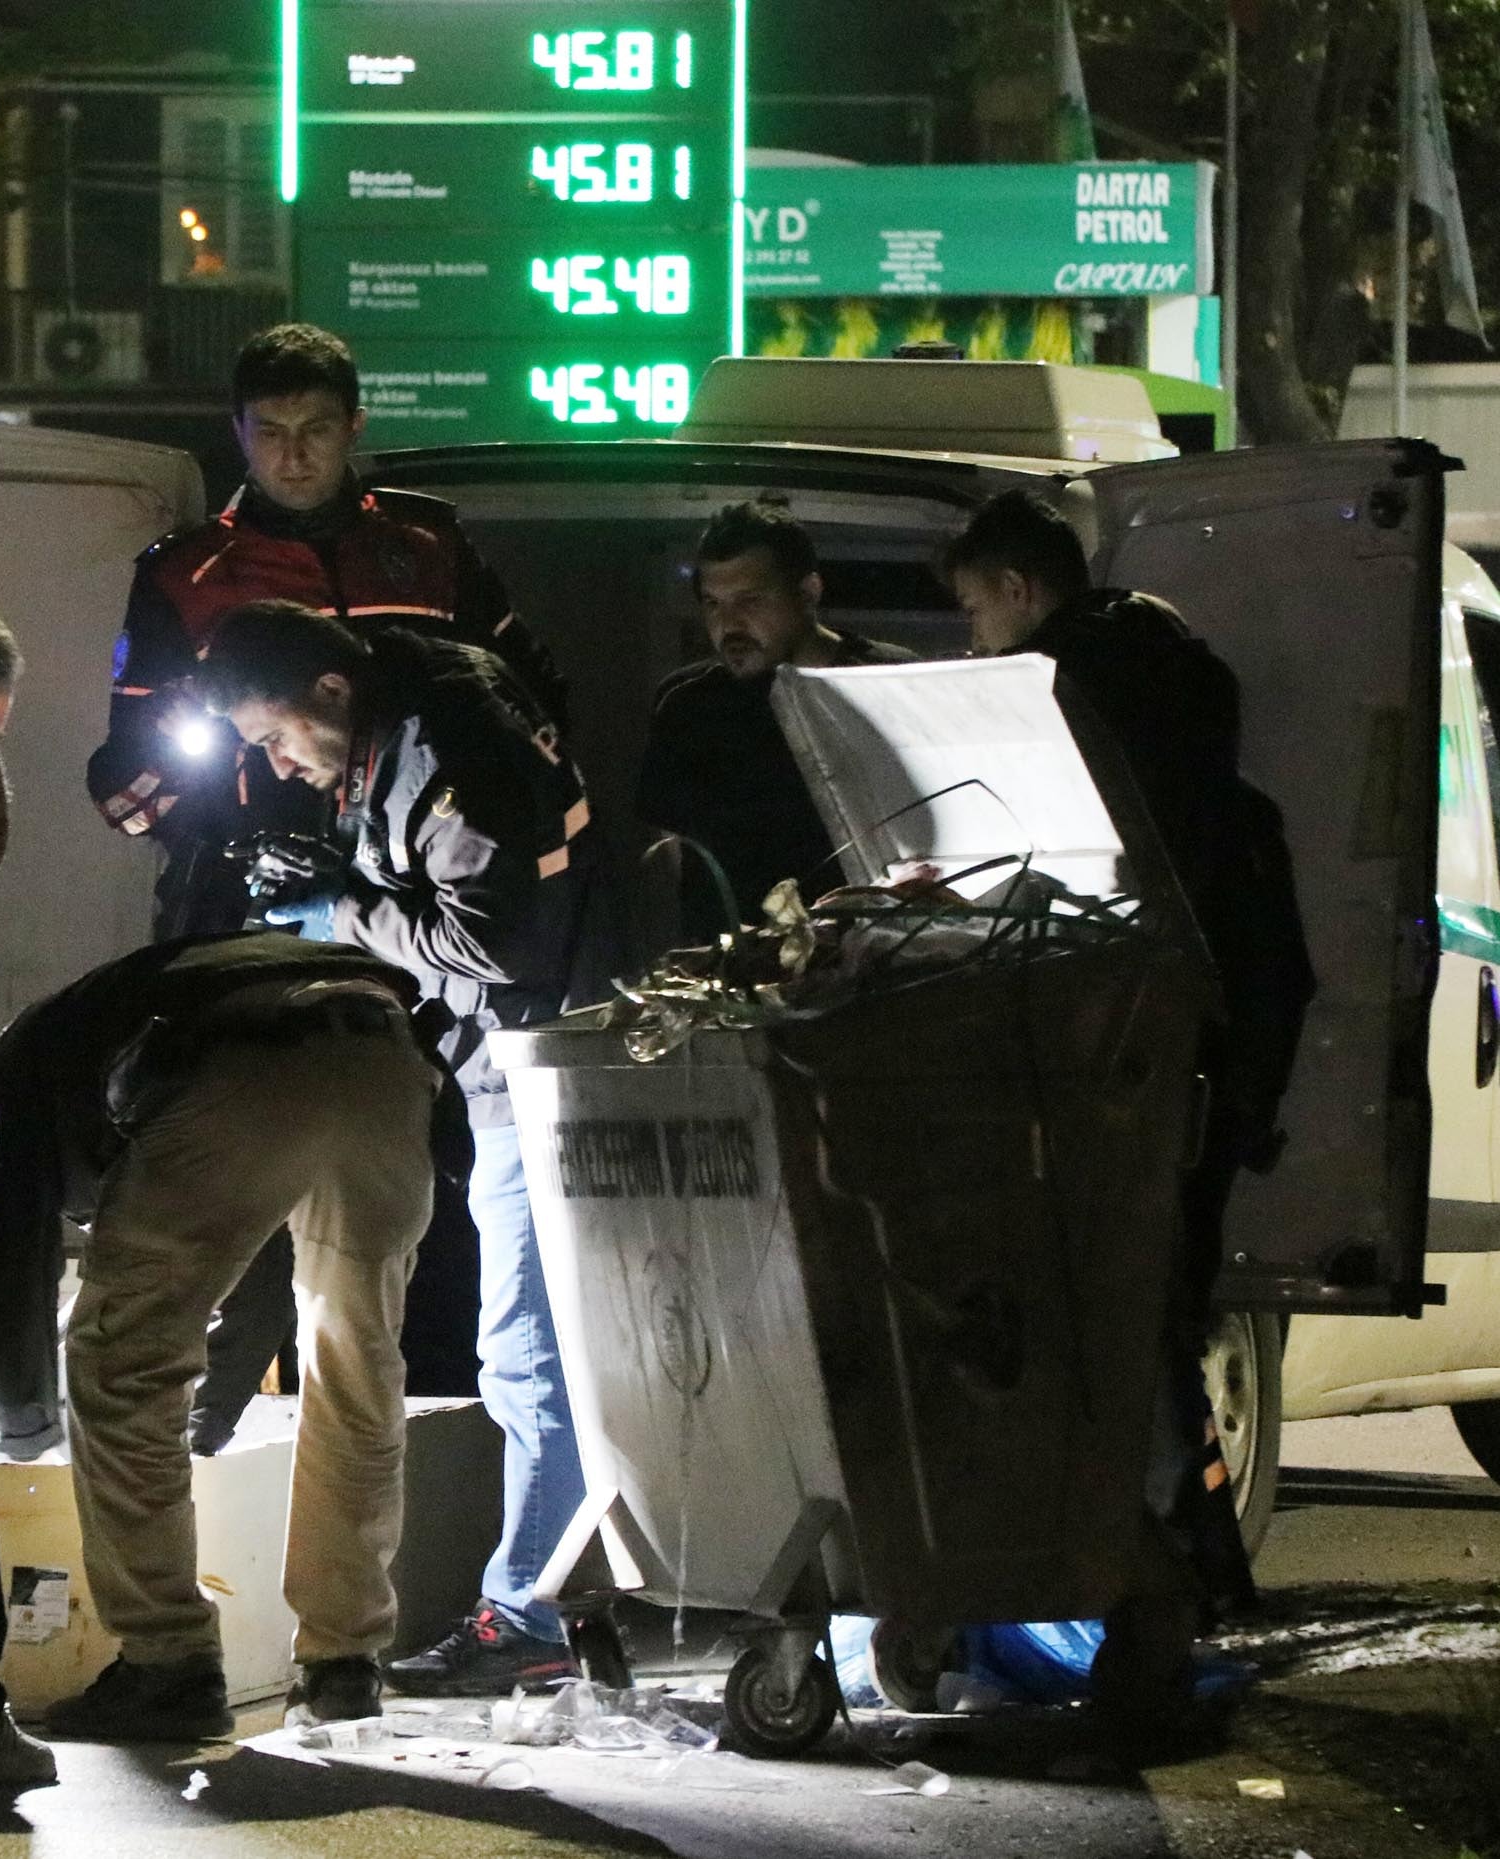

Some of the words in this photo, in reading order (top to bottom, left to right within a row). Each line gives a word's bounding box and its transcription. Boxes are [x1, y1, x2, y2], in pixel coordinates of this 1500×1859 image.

[1076, 172, 1170, 207] DARTAR
[1076, 209, 1169, 244] PETROL
[1053, 261, 1189, 293] CAPTAIN
